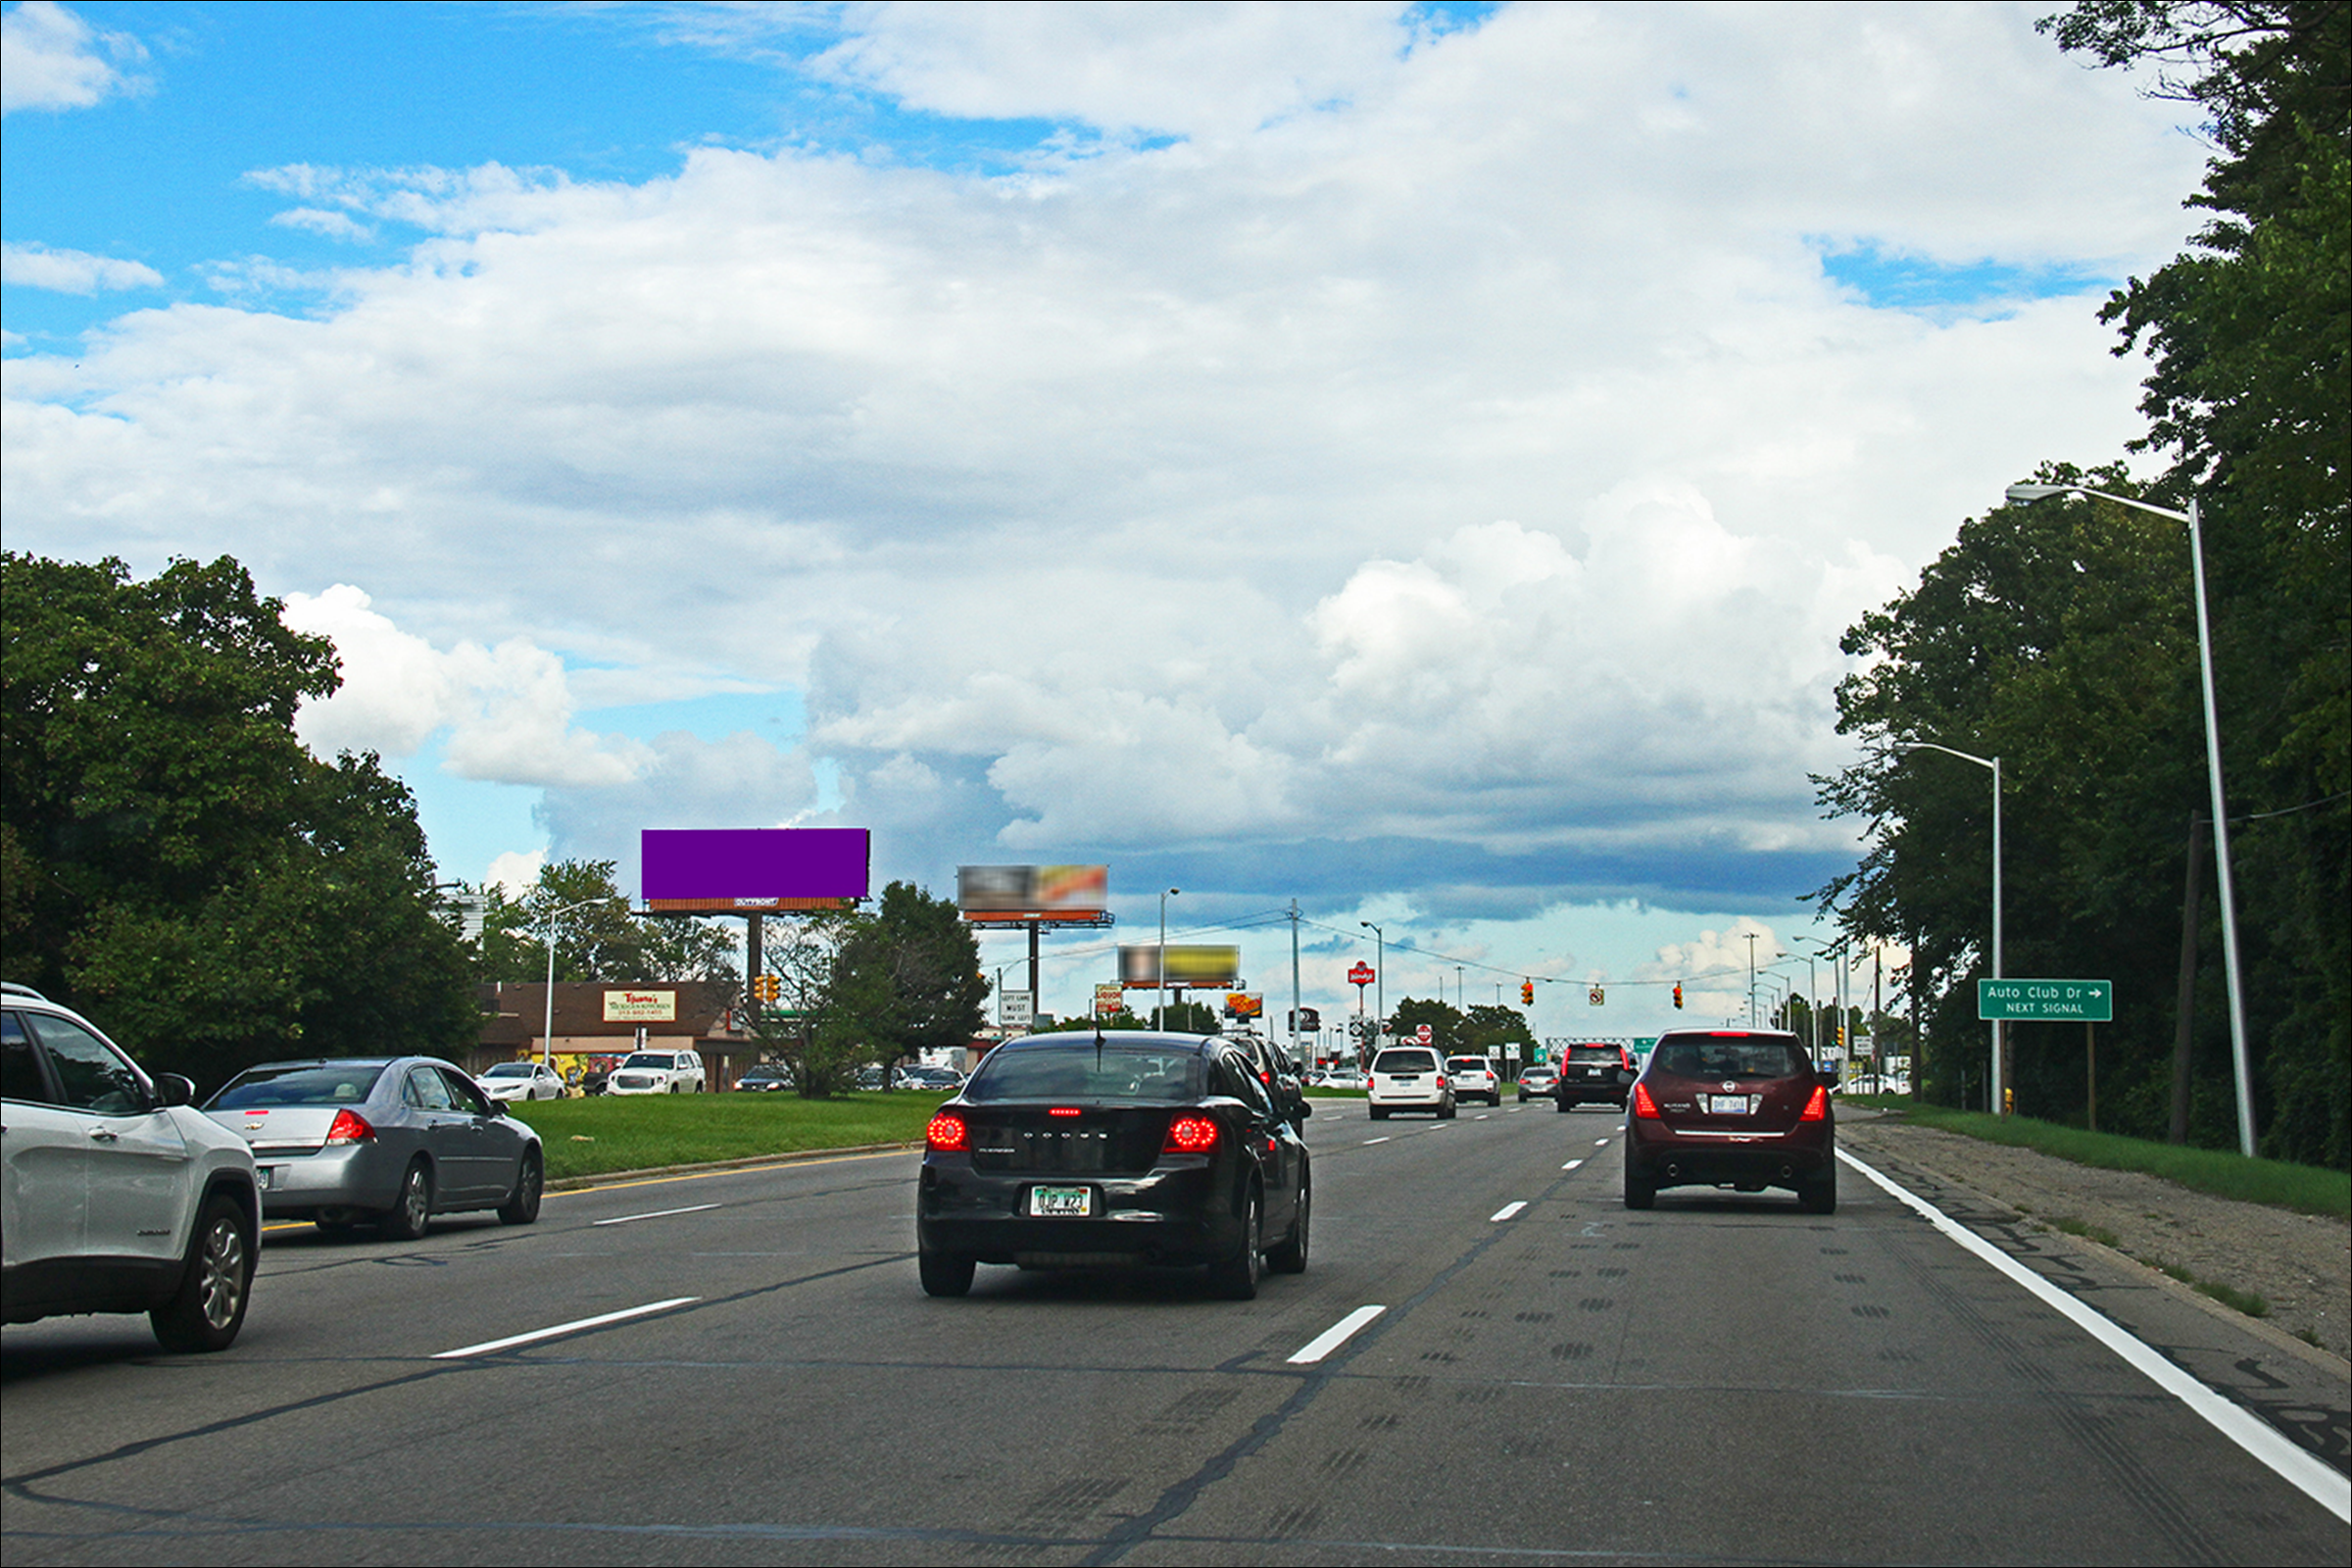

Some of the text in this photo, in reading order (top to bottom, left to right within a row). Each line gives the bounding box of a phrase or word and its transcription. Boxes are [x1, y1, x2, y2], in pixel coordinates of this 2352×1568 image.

[1987, 986, 2082, 999] Auto Club Dr
[2006, 1003, 2083, 1013] NEXT SIGNAL
